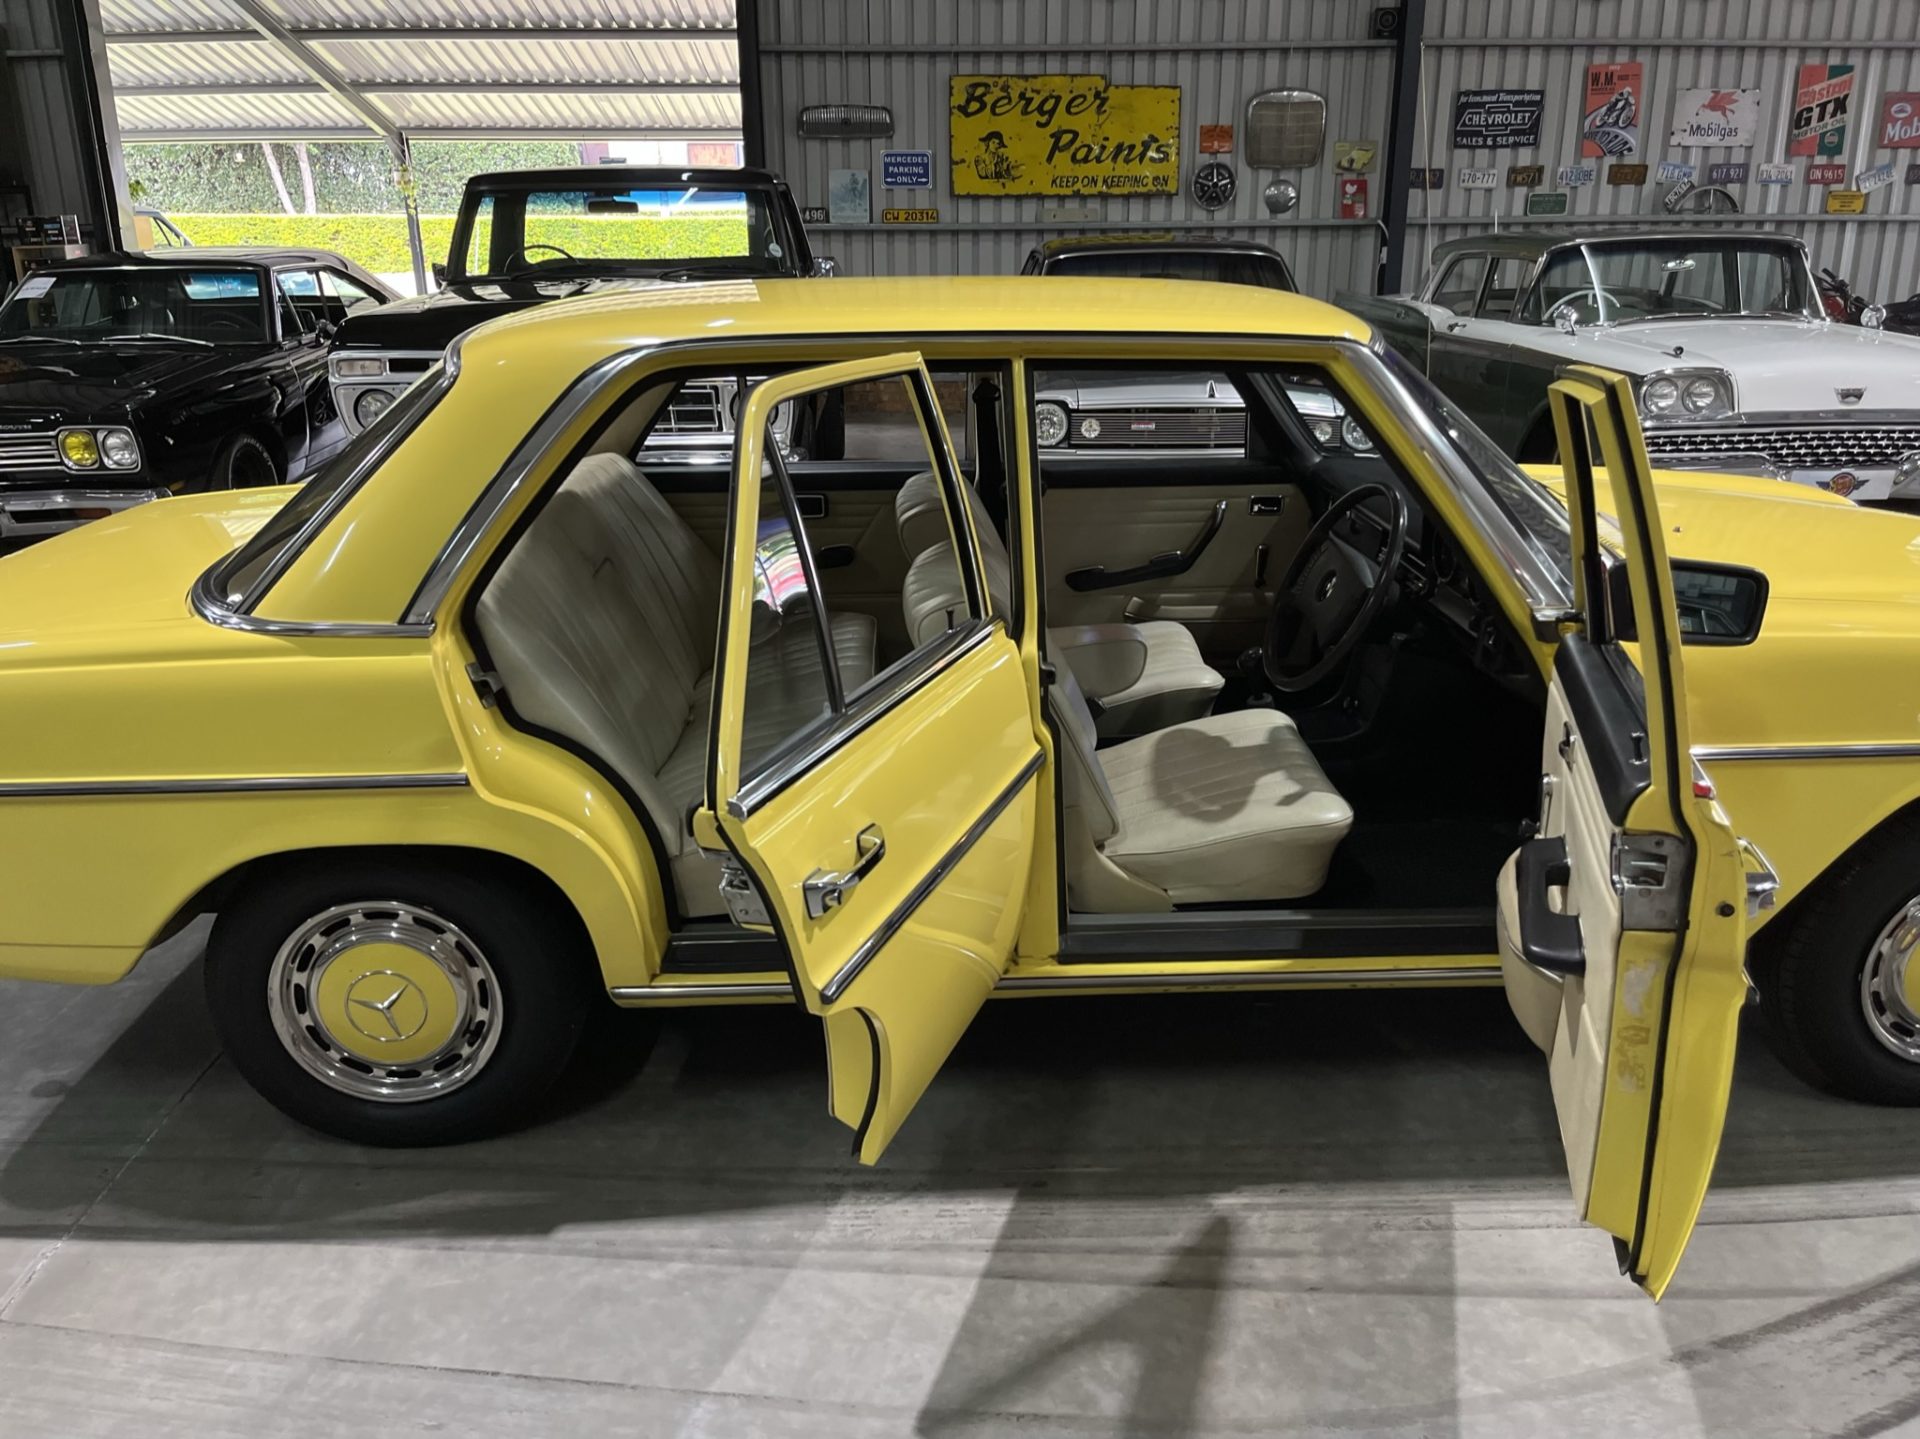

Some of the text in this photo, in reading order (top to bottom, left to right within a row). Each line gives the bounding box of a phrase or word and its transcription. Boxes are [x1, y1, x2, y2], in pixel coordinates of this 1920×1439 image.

[1590, 71, 1617, 87] W.M.
[957, 81, 1110, 129] Berger
[1793, 92, 1851, 131] GTX
[1465, 112, 1531, 126] CHEVROLET
[1688, 122, 1739, 141] Mobilgas
[1792, 123, 1829, 139] MOTOR
[1046, 128, 1170, 166] Paints
[1456, 135, 1535, 146] SALES & SERVICE
[888, 166, 924, 174] PARKING
[1712, 167, 1743, 179] 617 921
[1824, 168, 1844, 180] 9615
[896, 176, 918, 184] ONLY
[1051, 174, 1170, 189] KEEP ON KEEPING ON
[885, 211, 936, 221] CW 20314
